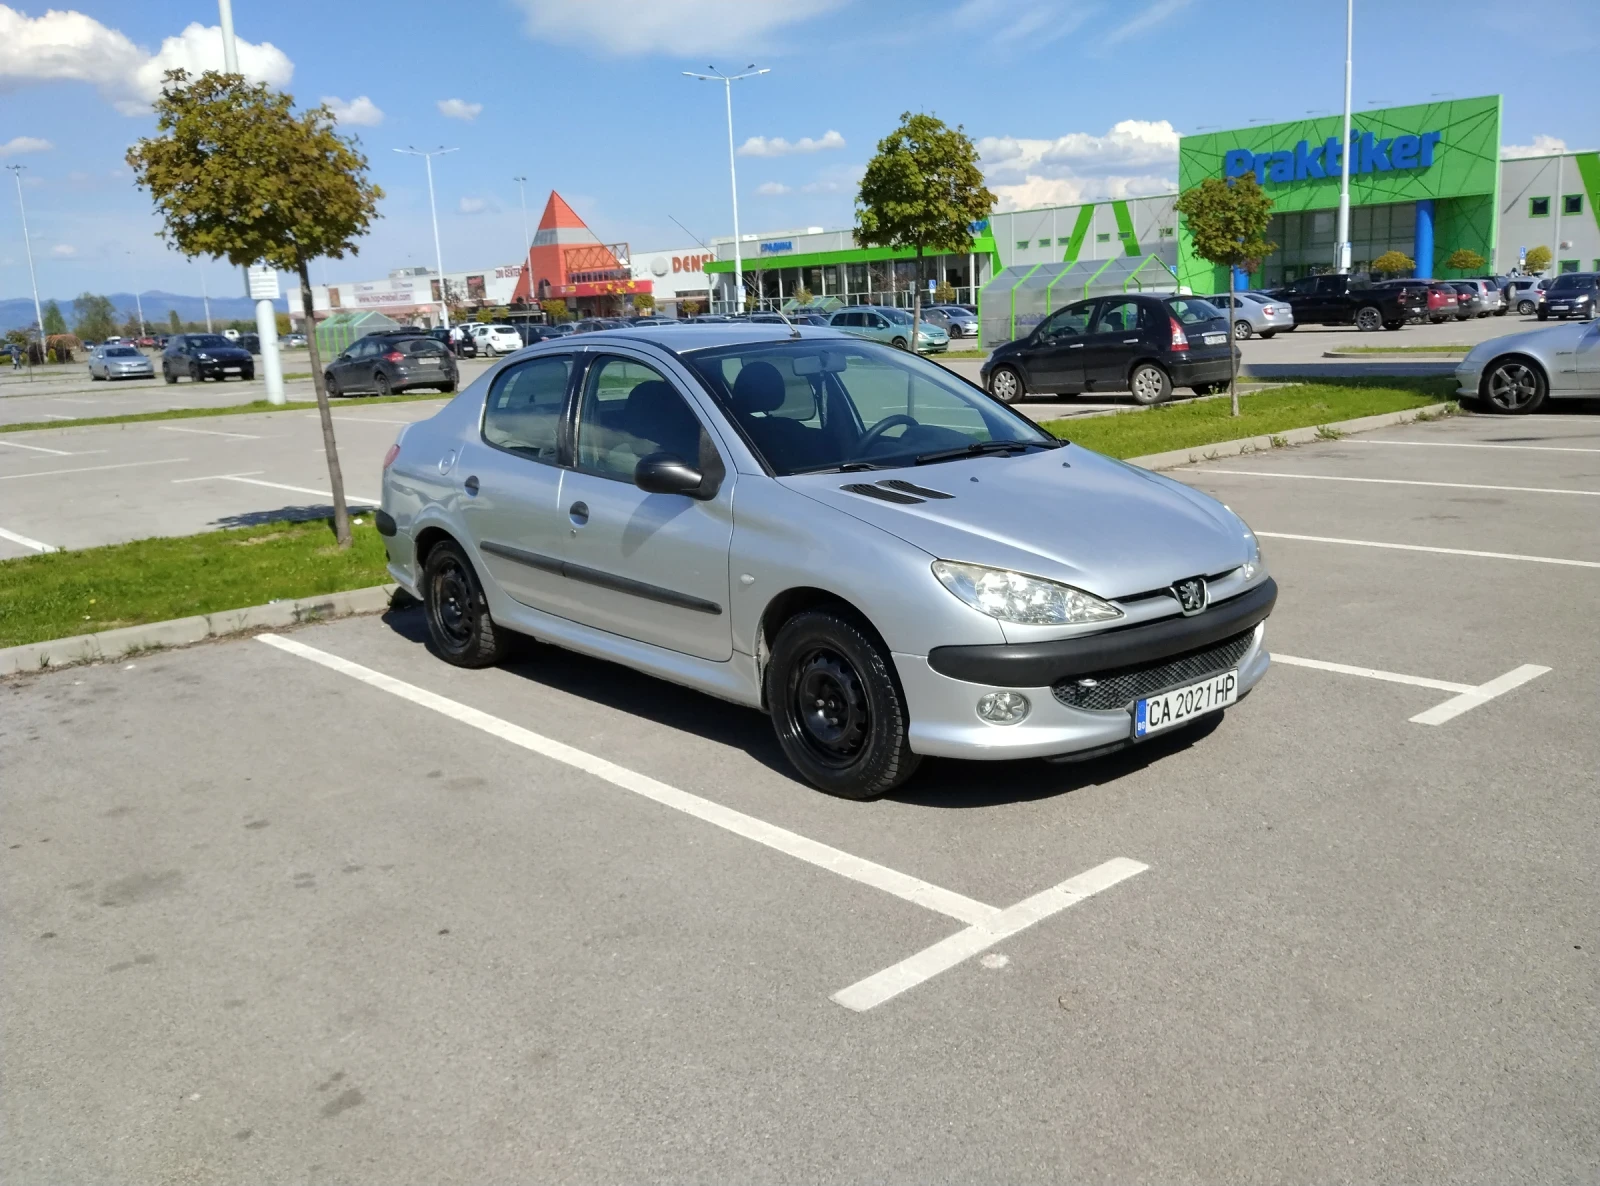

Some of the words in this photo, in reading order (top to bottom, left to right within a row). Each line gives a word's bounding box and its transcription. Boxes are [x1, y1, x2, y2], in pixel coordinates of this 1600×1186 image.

[1225, 129, 1441, 187] Praktiker
[1137, 721, 1146, 731] BG
[1149, 697, 1171, 726] CA
[1175, 683, 1211, 719] 2021
[1214, 673, 1235, 704] HP
